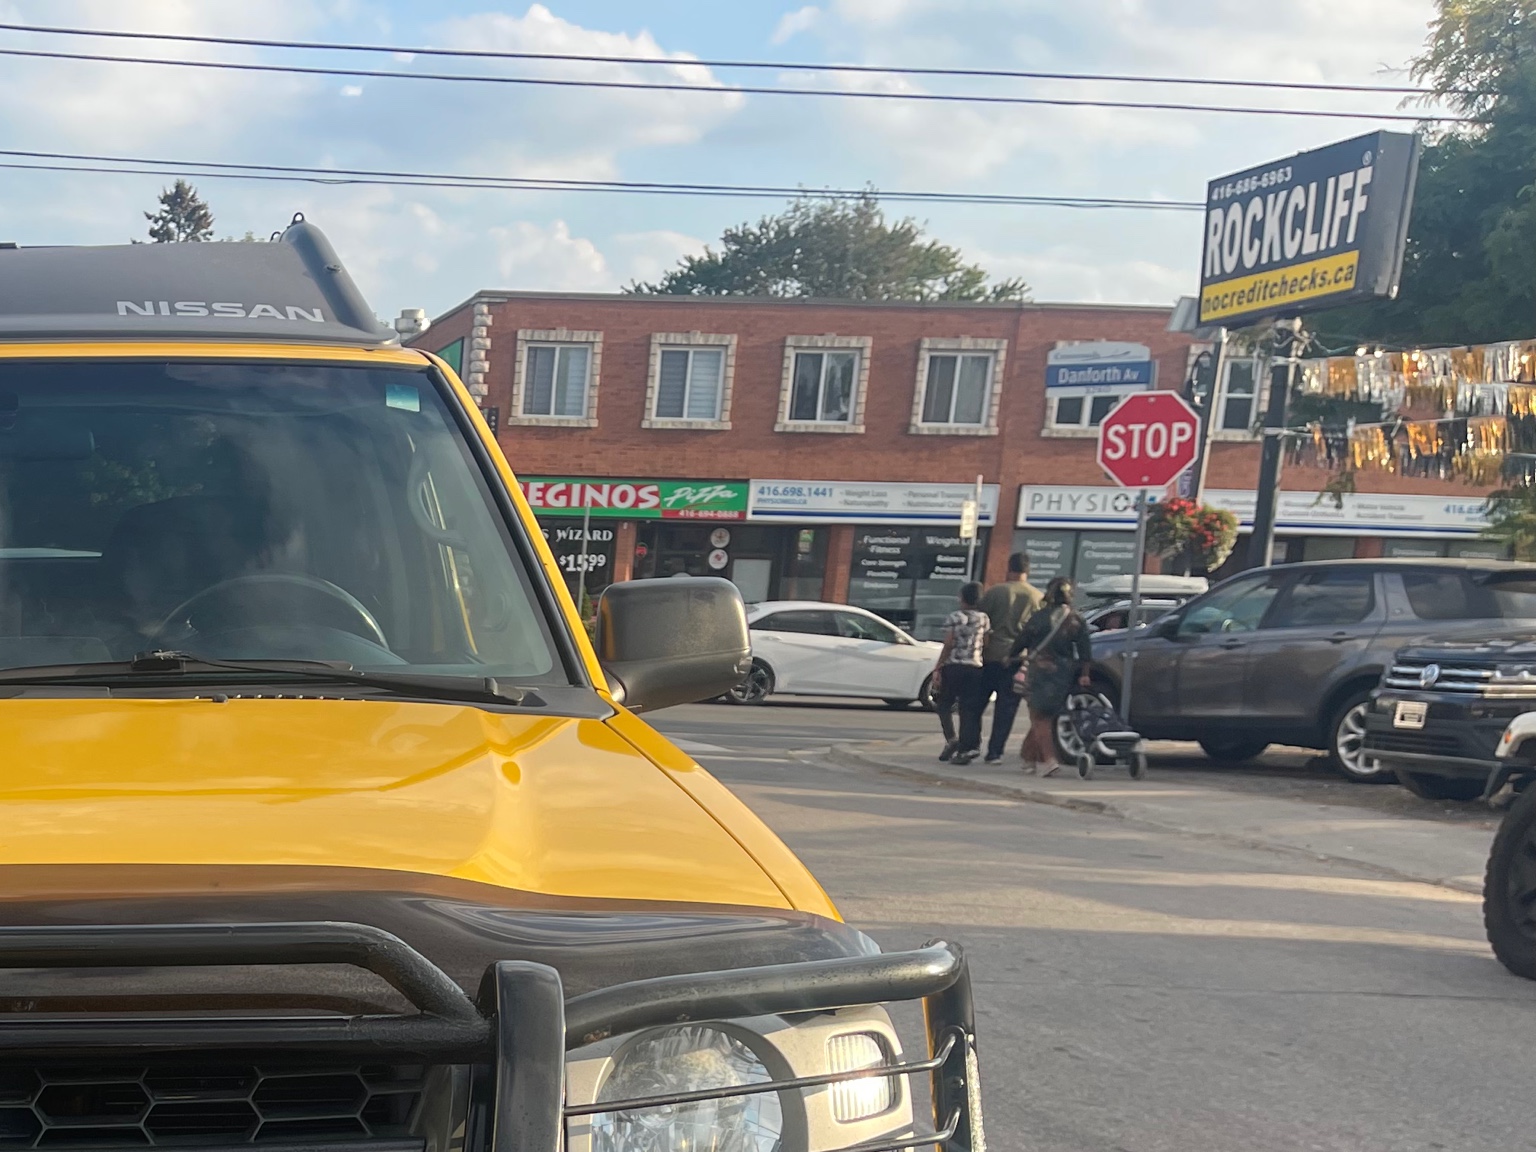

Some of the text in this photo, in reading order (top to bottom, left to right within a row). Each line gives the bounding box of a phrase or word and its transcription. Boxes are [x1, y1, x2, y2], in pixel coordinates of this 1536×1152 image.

[1211, 165, 1293, 201] 416-686-6963
[1205, 166, 1373, 279] ROCKCLIFF
[1201, 263, 1355, 315] nocreditchecks.ca
[116, 300, 325, 322] NISSAN
[1058, 366, 1122, 384] Danforth
[1105, 421, 1193, 460] STOP
[758, 486, 833, 497] 416.698.1441
